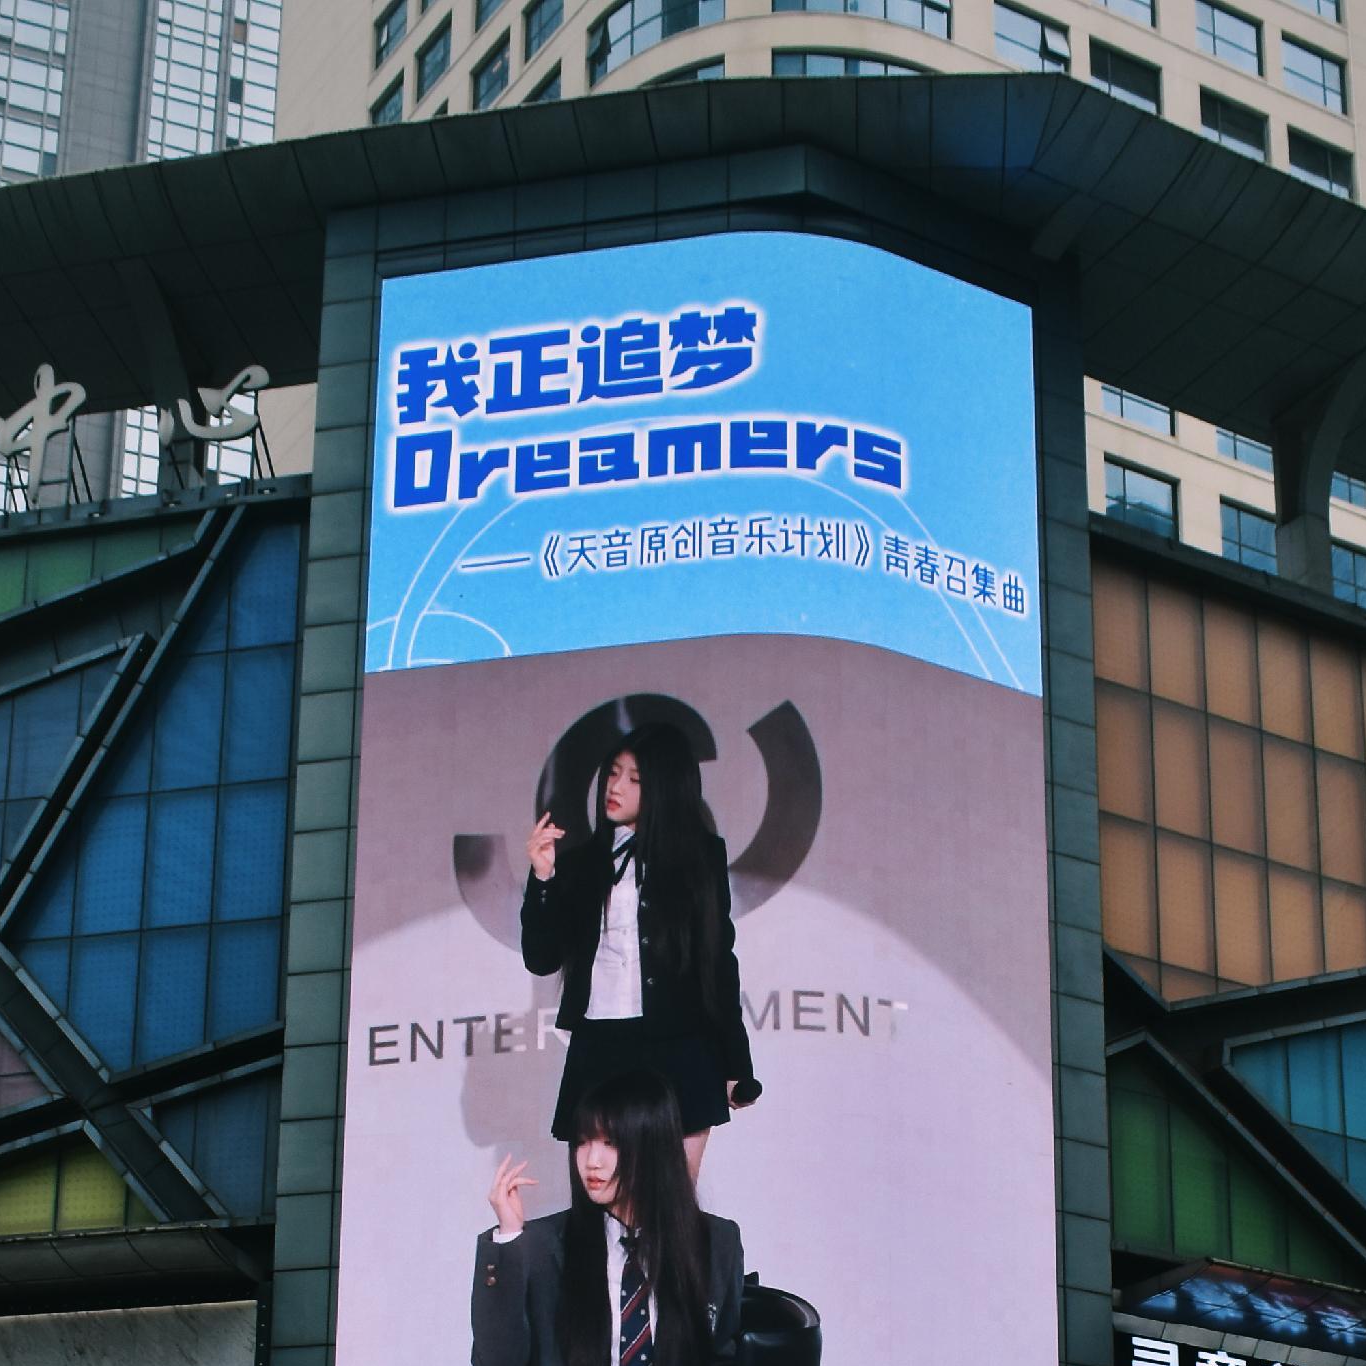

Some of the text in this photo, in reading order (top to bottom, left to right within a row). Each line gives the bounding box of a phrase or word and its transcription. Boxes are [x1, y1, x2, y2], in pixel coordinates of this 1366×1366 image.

[396, 306, 759, 426] 我正追梦
[393, 419, 904, 509] Dreamers
